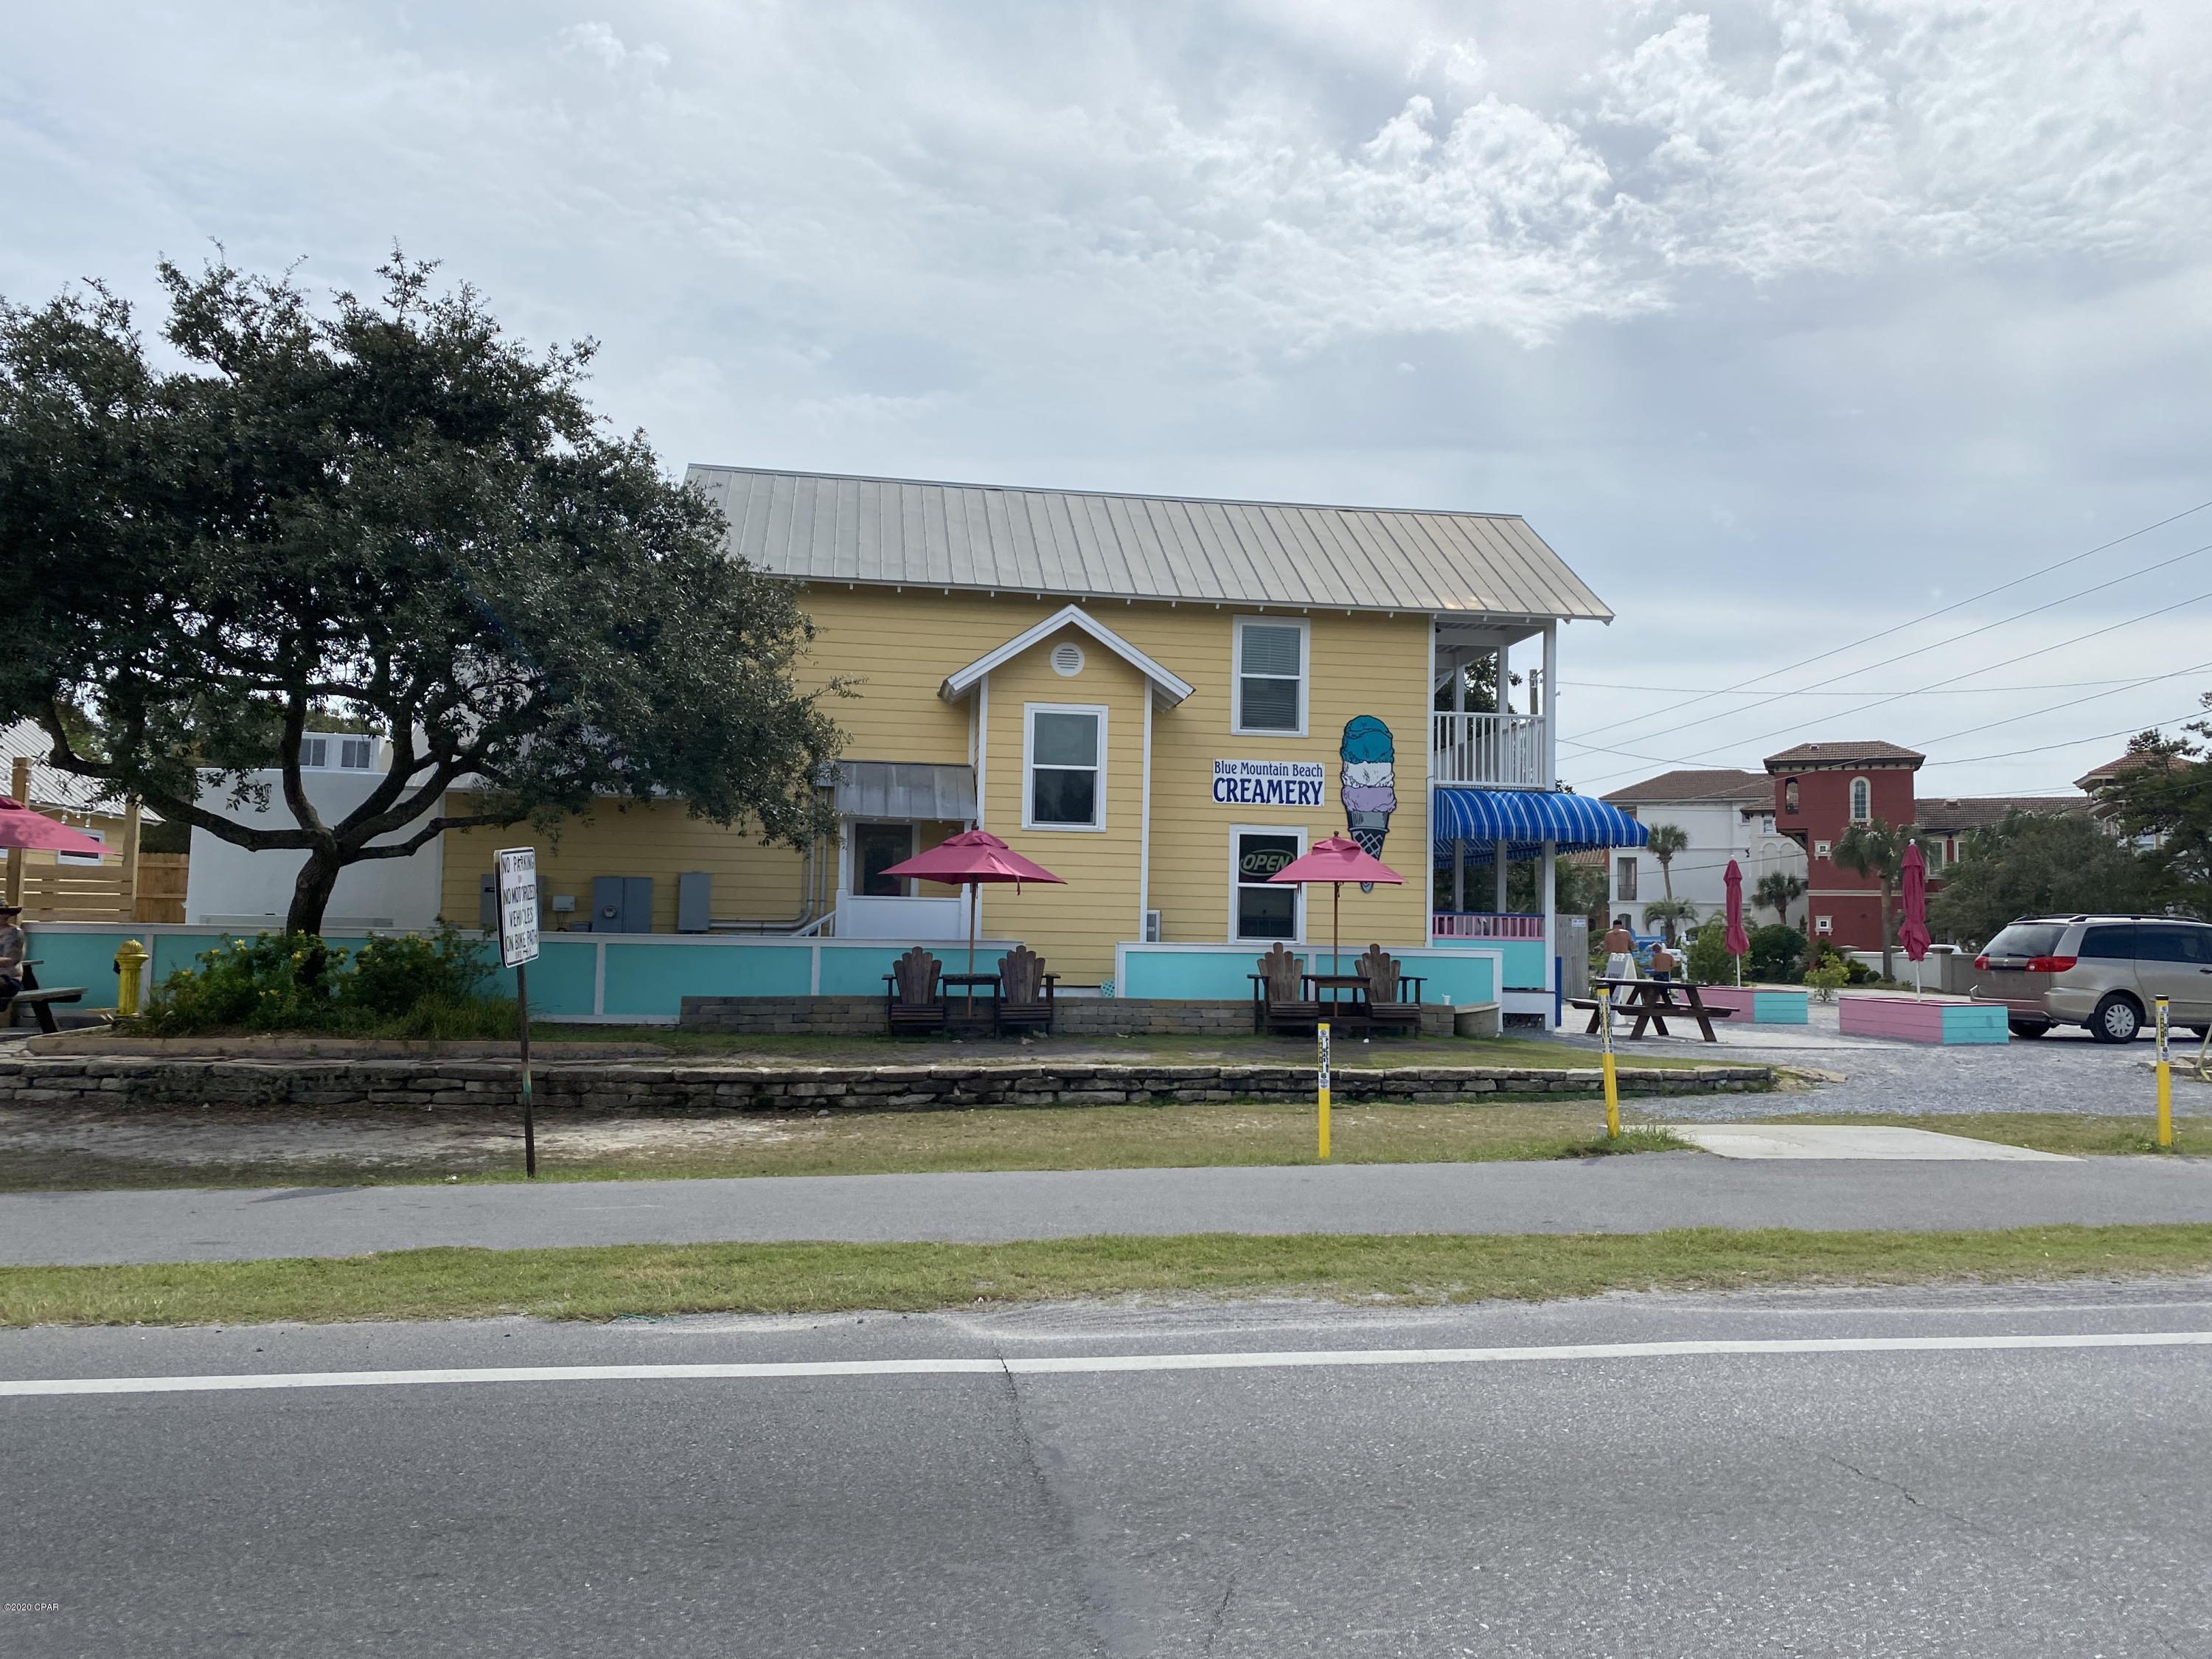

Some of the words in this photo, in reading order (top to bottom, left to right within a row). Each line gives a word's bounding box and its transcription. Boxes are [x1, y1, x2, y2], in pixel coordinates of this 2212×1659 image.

[1214, 761, 1237, 774] Blue
[1240, 762, 1289, 776] Mountain
[1293, 764, 1323, 777] Beach
[1214, 777, 1323, 805] CREAMERY
[503, 857, 510, 874] NO
[513, 855, 535, 873] PARKING
[1242, 854, 1290, 871] OPEN
[504, 888, 511, 905] NO
[512, 884, 535, 903] MOTORIZED
[507, 935, 513, 952] ON
[515, 932, 526, 950] BIKE
[527, 929, 538, 946] PATH
